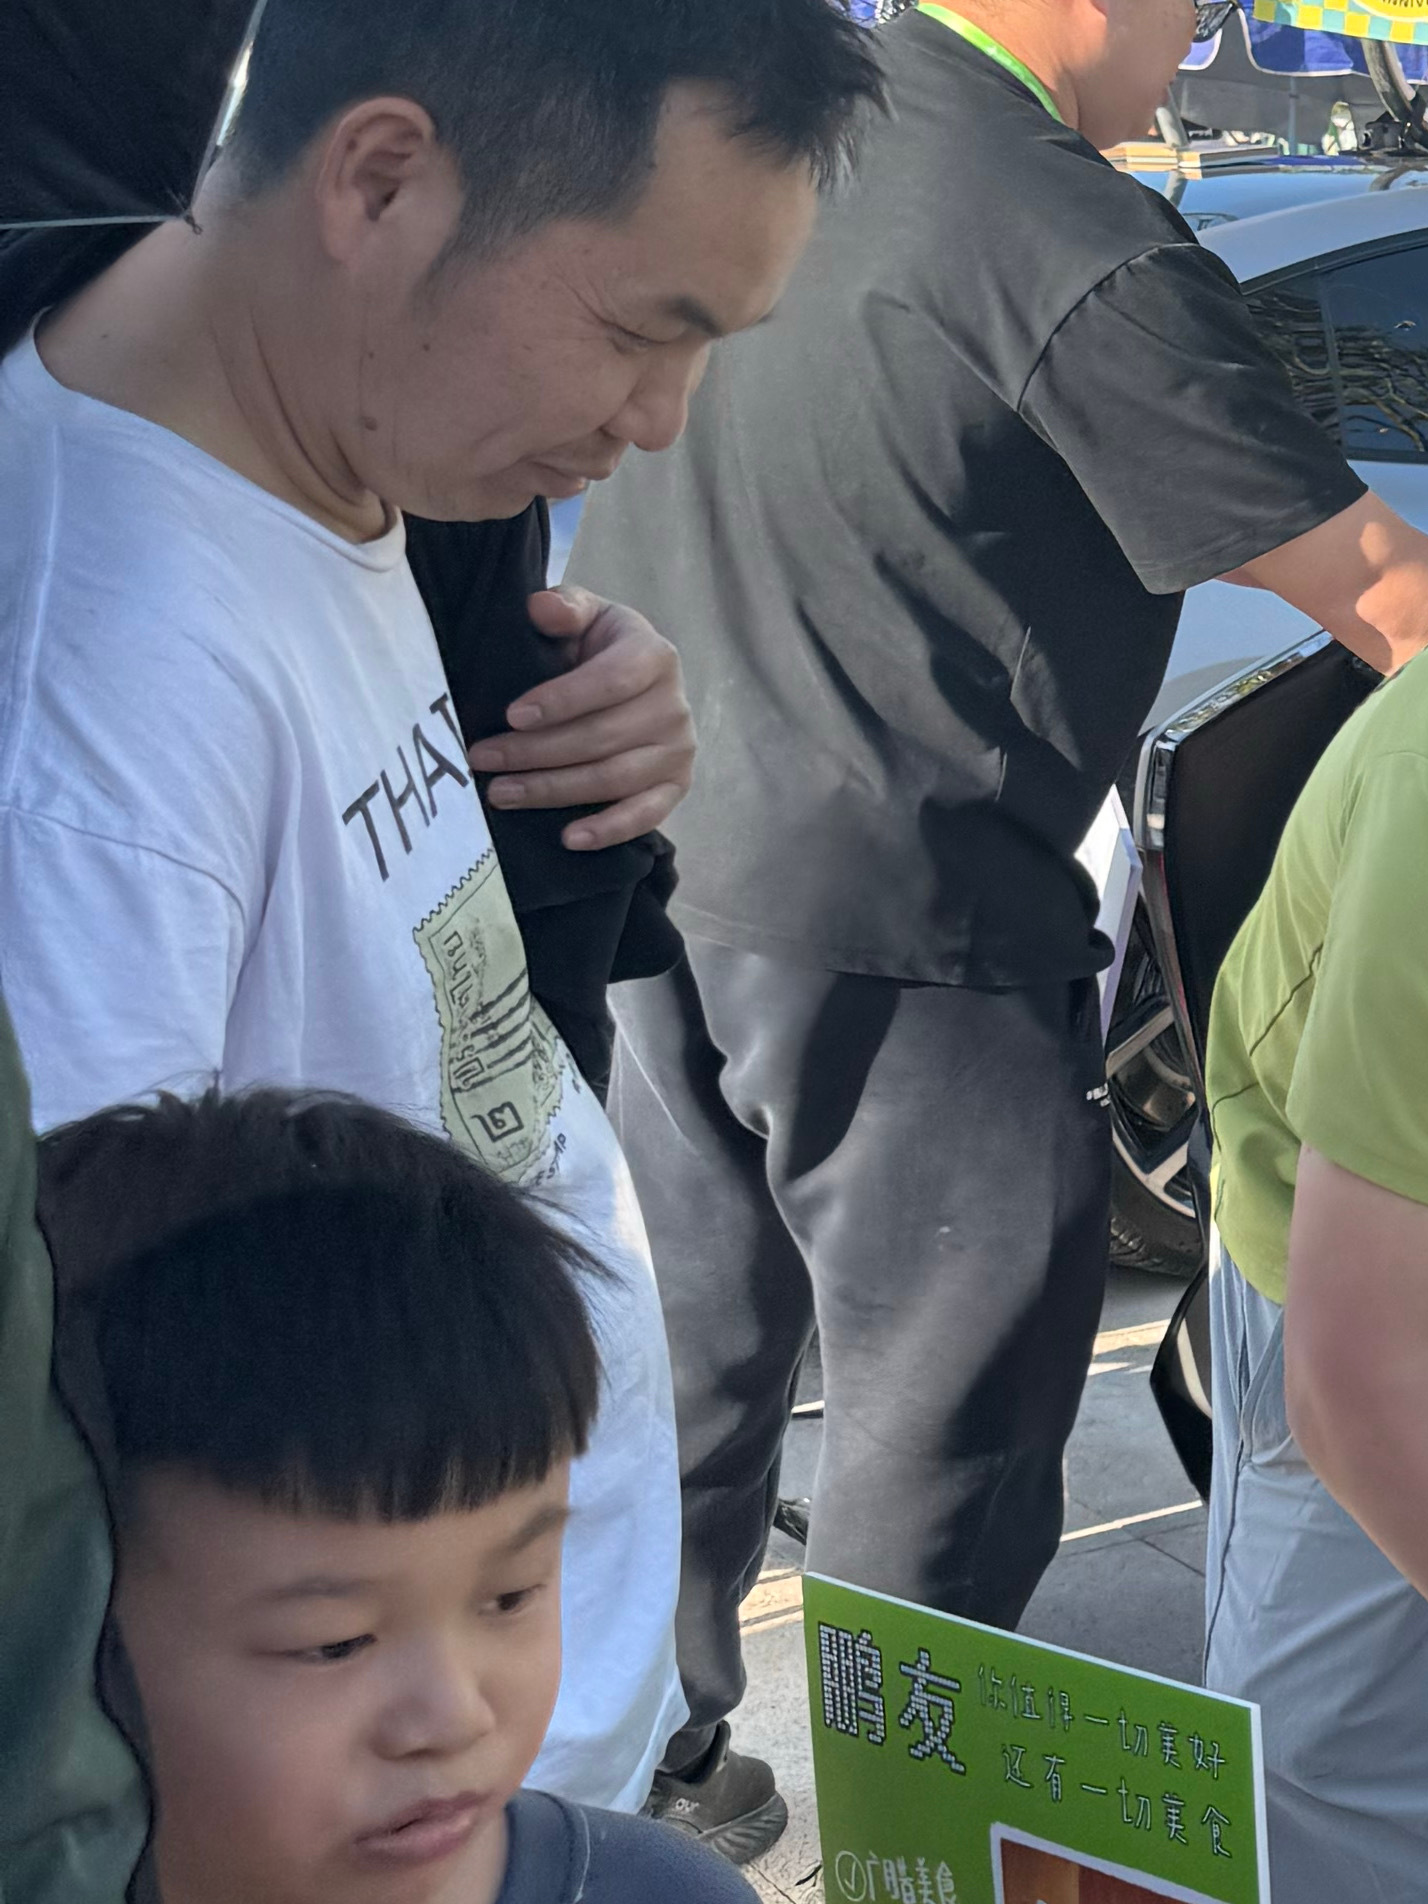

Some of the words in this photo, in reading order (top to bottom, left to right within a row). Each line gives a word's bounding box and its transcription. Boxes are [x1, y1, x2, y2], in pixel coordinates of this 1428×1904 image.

[818, 1621, 967, 1776] 鹏友
[977, 1663, 1226, 1780] 你值得一切美好
[1001, 1743, 1232, 1859] 还有一切美食
